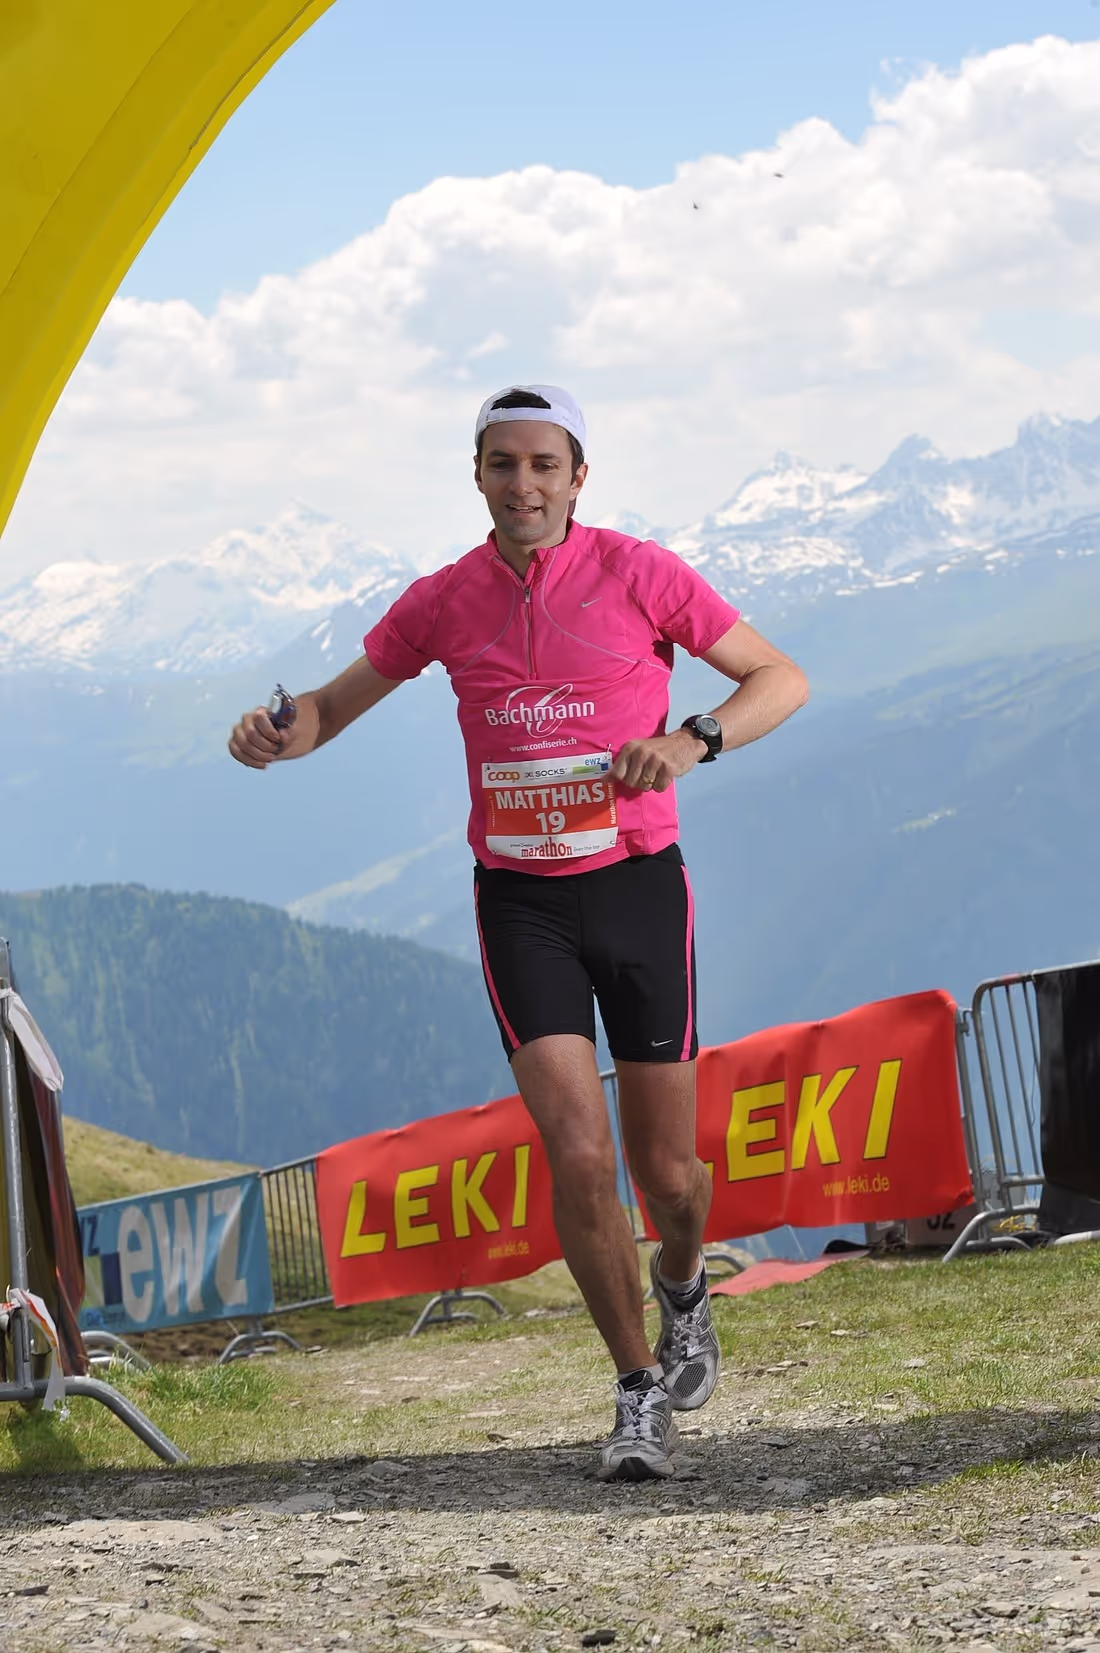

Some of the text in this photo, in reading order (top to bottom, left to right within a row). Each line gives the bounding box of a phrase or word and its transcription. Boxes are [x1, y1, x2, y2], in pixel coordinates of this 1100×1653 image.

[485, 701, 595, 726] Bachmann
[509, 737, 577, 752] www.confiserie.ch
[585, 757, 601, 766] ewz
[488, 771, 520, 783] coop
[495, 782, 606, 810] MATTHIAS
[536, 811, 566, 834] 19
[521, 837, 573, 857] marathon
[704, 1058, 903, 1182] EKI
[823, 1174, 890, 1197] www.leki.de
[340, 1143, 531, 1259] LEKI
[117, 1186, 248, 1323] ewz
